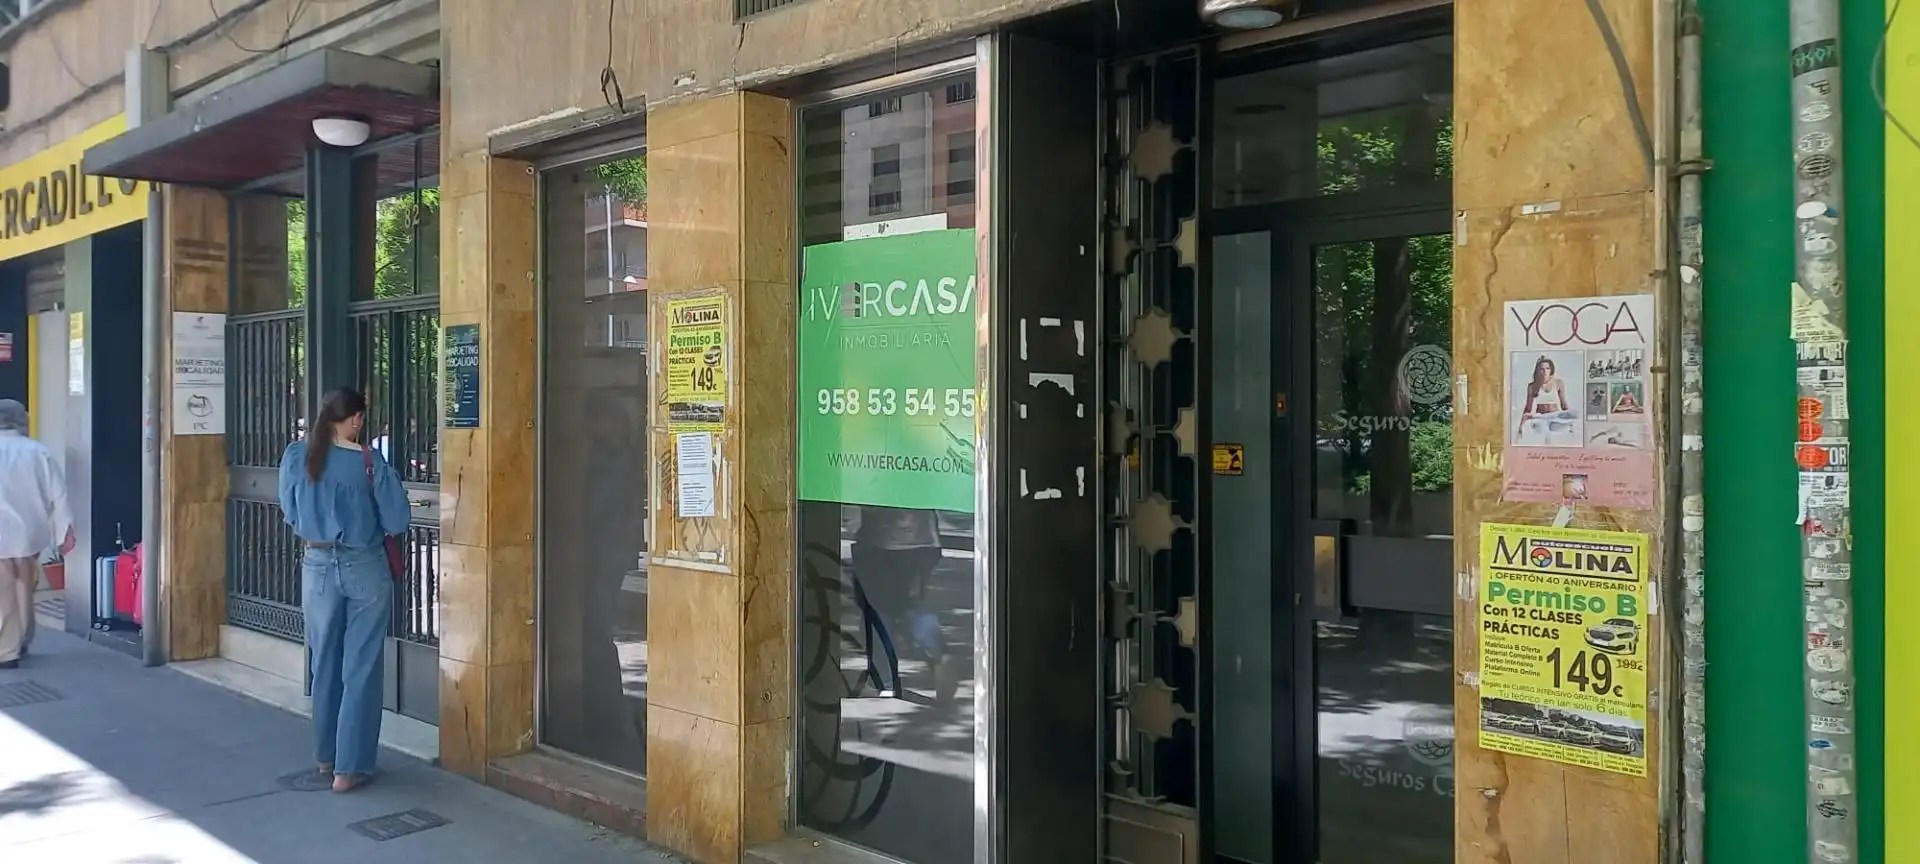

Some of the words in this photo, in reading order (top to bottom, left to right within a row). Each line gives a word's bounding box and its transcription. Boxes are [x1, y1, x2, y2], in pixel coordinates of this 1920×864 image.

[404, 204, 420, 228] 82
[672, 306, 720, 325] MOLINA
[1510, 301, 1645, 346] YOGA
[670, 331, 710, 347] Permiso
[713, 331, 721, 345] B
[839, 332, 951, 351] INMOBILIARIA
[817, 388, 860, 415] 958
[867, 387, 897, 415] 53
[904, 388, 937, 416] 54
[944, 388, 975, 417] 55
[1331, 409, 1420, 437] Seguros
[827, 452, 964, 473] WWW.IVERCASA.COM
[1493, 535, 1633, 574] MOLINA
[1532, 539, 1633, 553] autoescuelas
[1495, 570, 1544, 585] OFERTÓN
[1546, 576, 1560, 585] 40
[1563, 579, 1637, 592] ANIVERSARIO
[1488, 581, 1606, 614] Permiso
[1616, 593, 1638, 617] B
[1483, 603, 1508, 616] Con
[1512, 606, 1526, 619] 12
[1529, 609, 1583, 625] CLASES
[1483, 619, 1560, 640] PRÁCTICAS
[1484, 656, 1503, 664] Curso
[1521, 645, 1541, 653] Oferta
[1520, 668, 1541, 677] Online
[1499, 689, 1508, 699] Tu
[1543, 698, 1554, 706] en
[1575, 702, 1592, 712] solo
[1596, 703, 1606, 713] 6
[1338, 758, 1425, 791] Seguros
